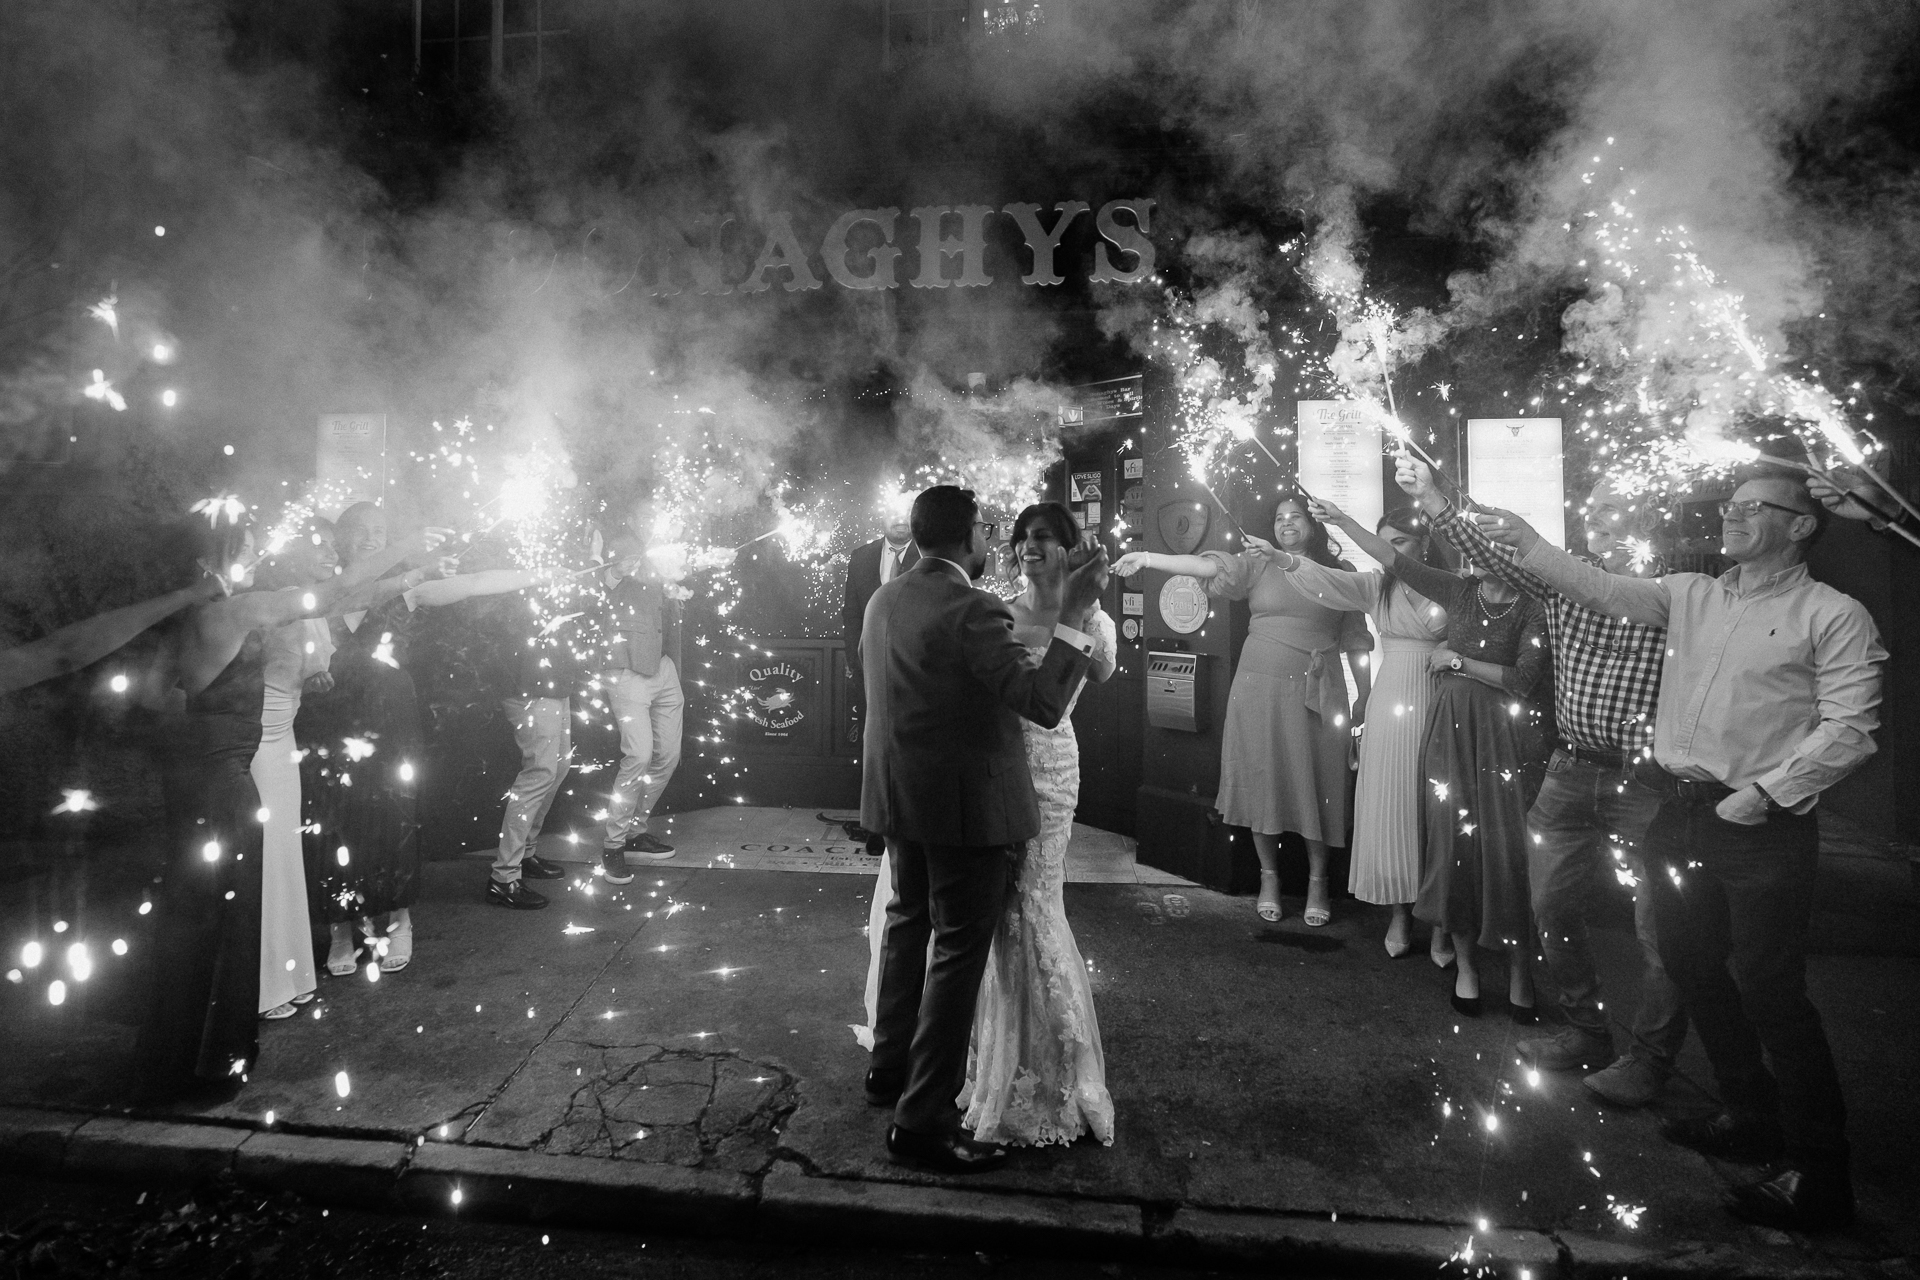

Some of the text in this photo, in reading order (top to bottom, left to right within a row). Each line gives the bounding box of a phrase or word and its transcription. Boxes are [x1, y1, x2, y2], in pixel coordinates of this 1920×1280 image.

[1316, 408, 1362, 422] The Grill
[332, 420, 370, 434] The Grill
[749, 662, 804, 682] Quality
[770, 710, 805, 729] Seafood
